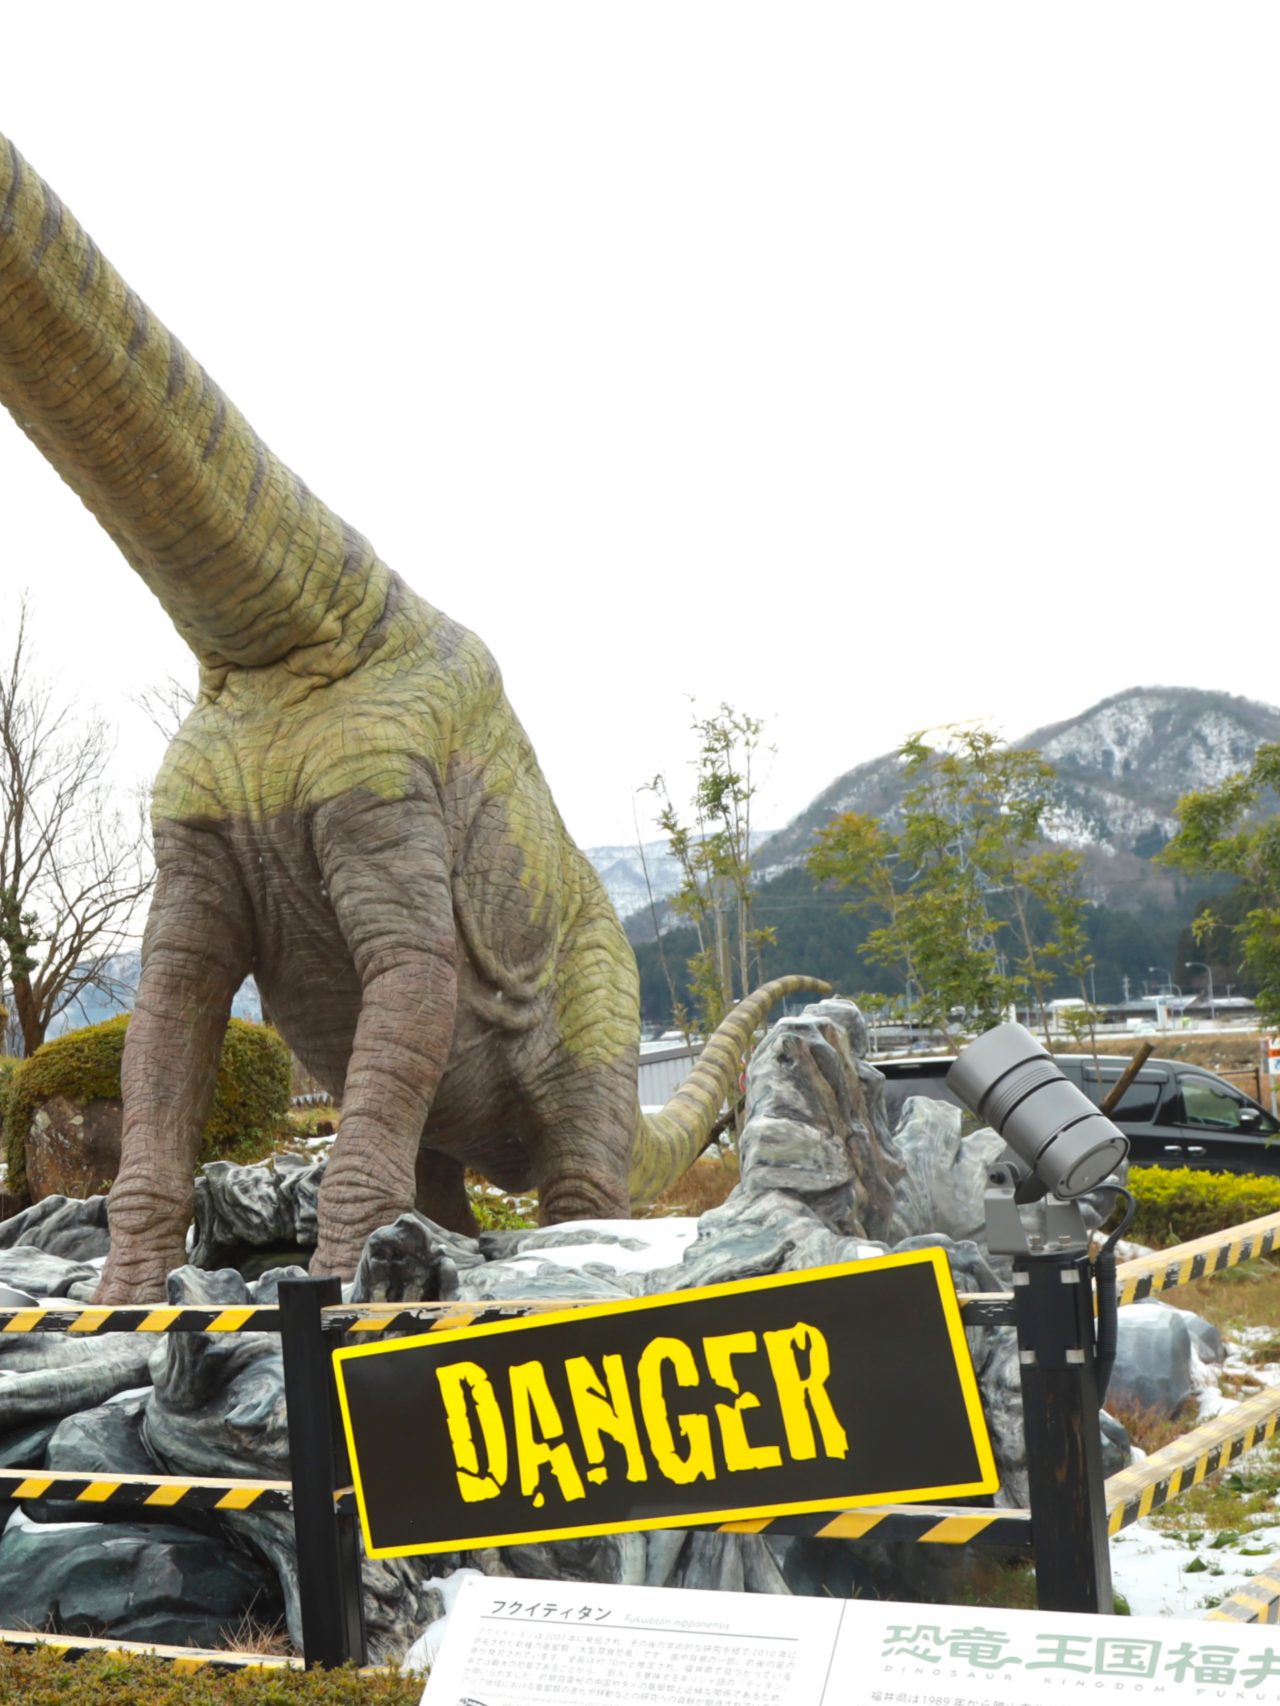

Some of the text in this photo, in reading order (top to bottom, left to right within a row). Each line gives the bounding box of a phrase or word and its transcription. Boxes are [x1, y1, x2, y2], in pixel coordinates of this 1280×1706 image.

[436, 1322, 849, 1508] DANGER
[491, 1599, 613, 1622] フクイティタン
[884, 1664, 1012, 1682] DINOSAUR
[1043, 1677, 1166, 1694] KINGDOM
